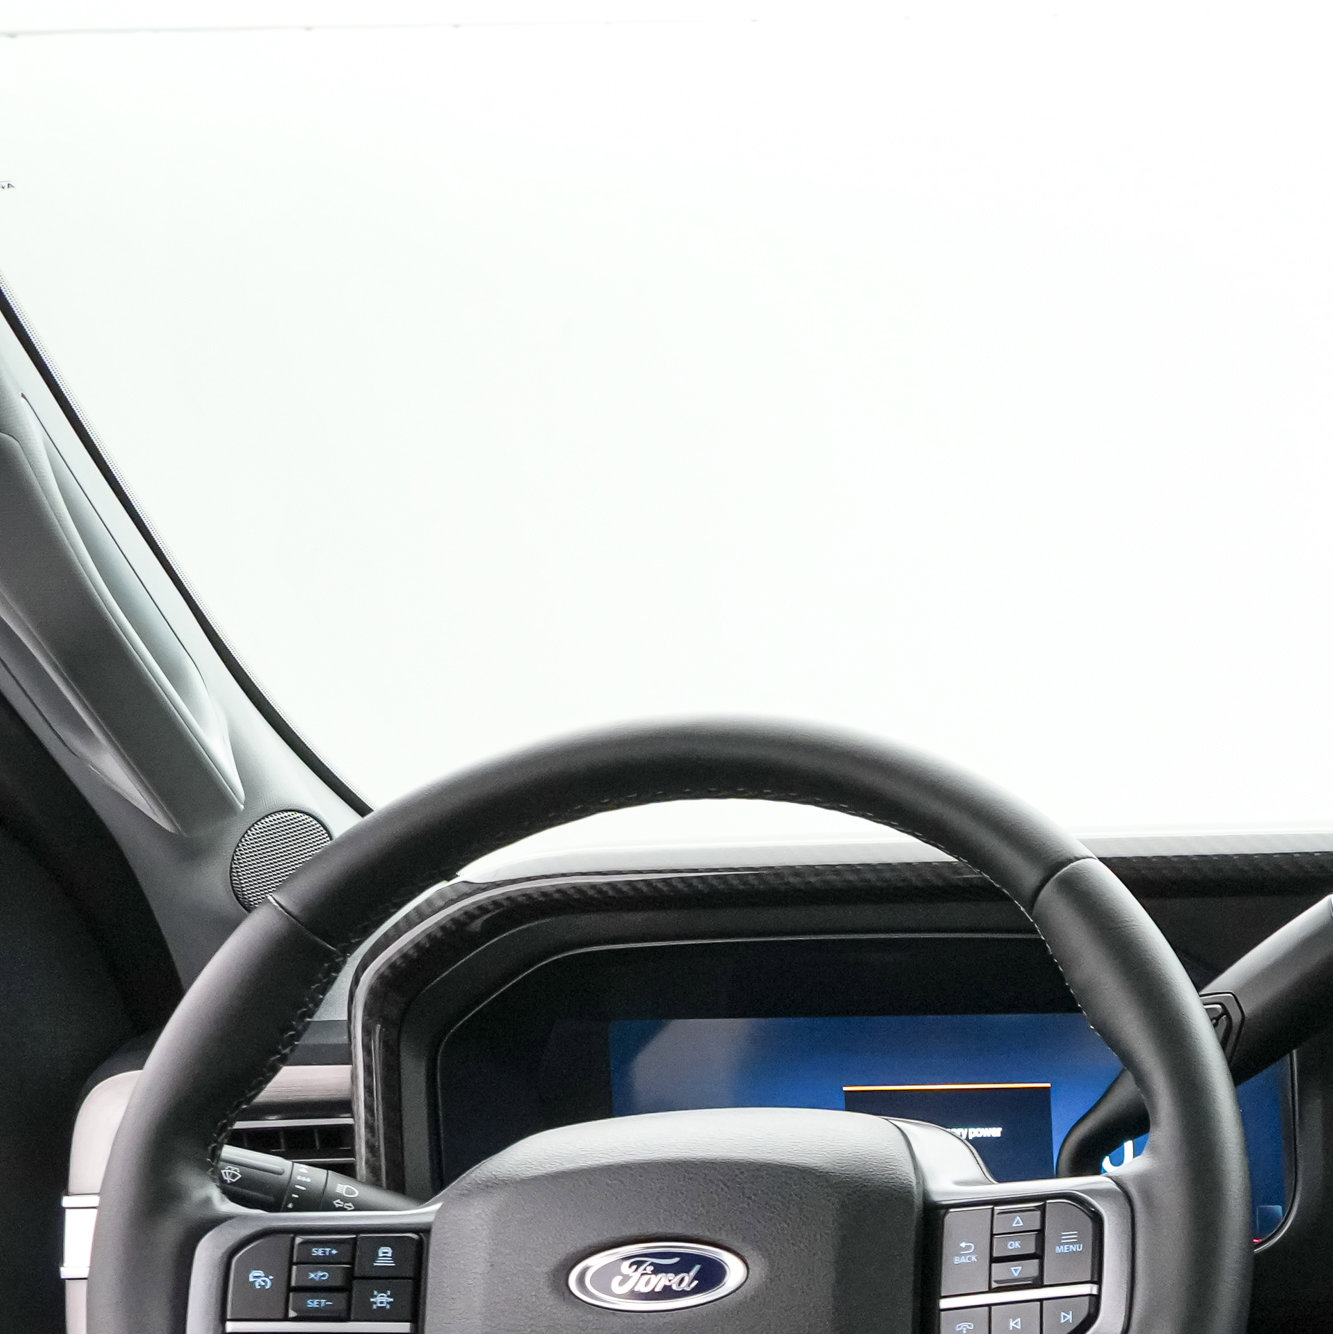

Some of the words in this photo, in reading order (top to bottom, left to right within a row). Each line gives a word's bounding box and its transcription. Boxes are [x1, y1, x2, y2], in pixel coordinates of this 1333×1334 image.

[1008, 1241, 1021, 1249] OK
[1056, 1244, 1083, 1253] MENU
[311, 1247, 338, 1256] SET+
[954, 1255, 977, 1263] BACK
[611, 1257, 703, 1295] Ford
